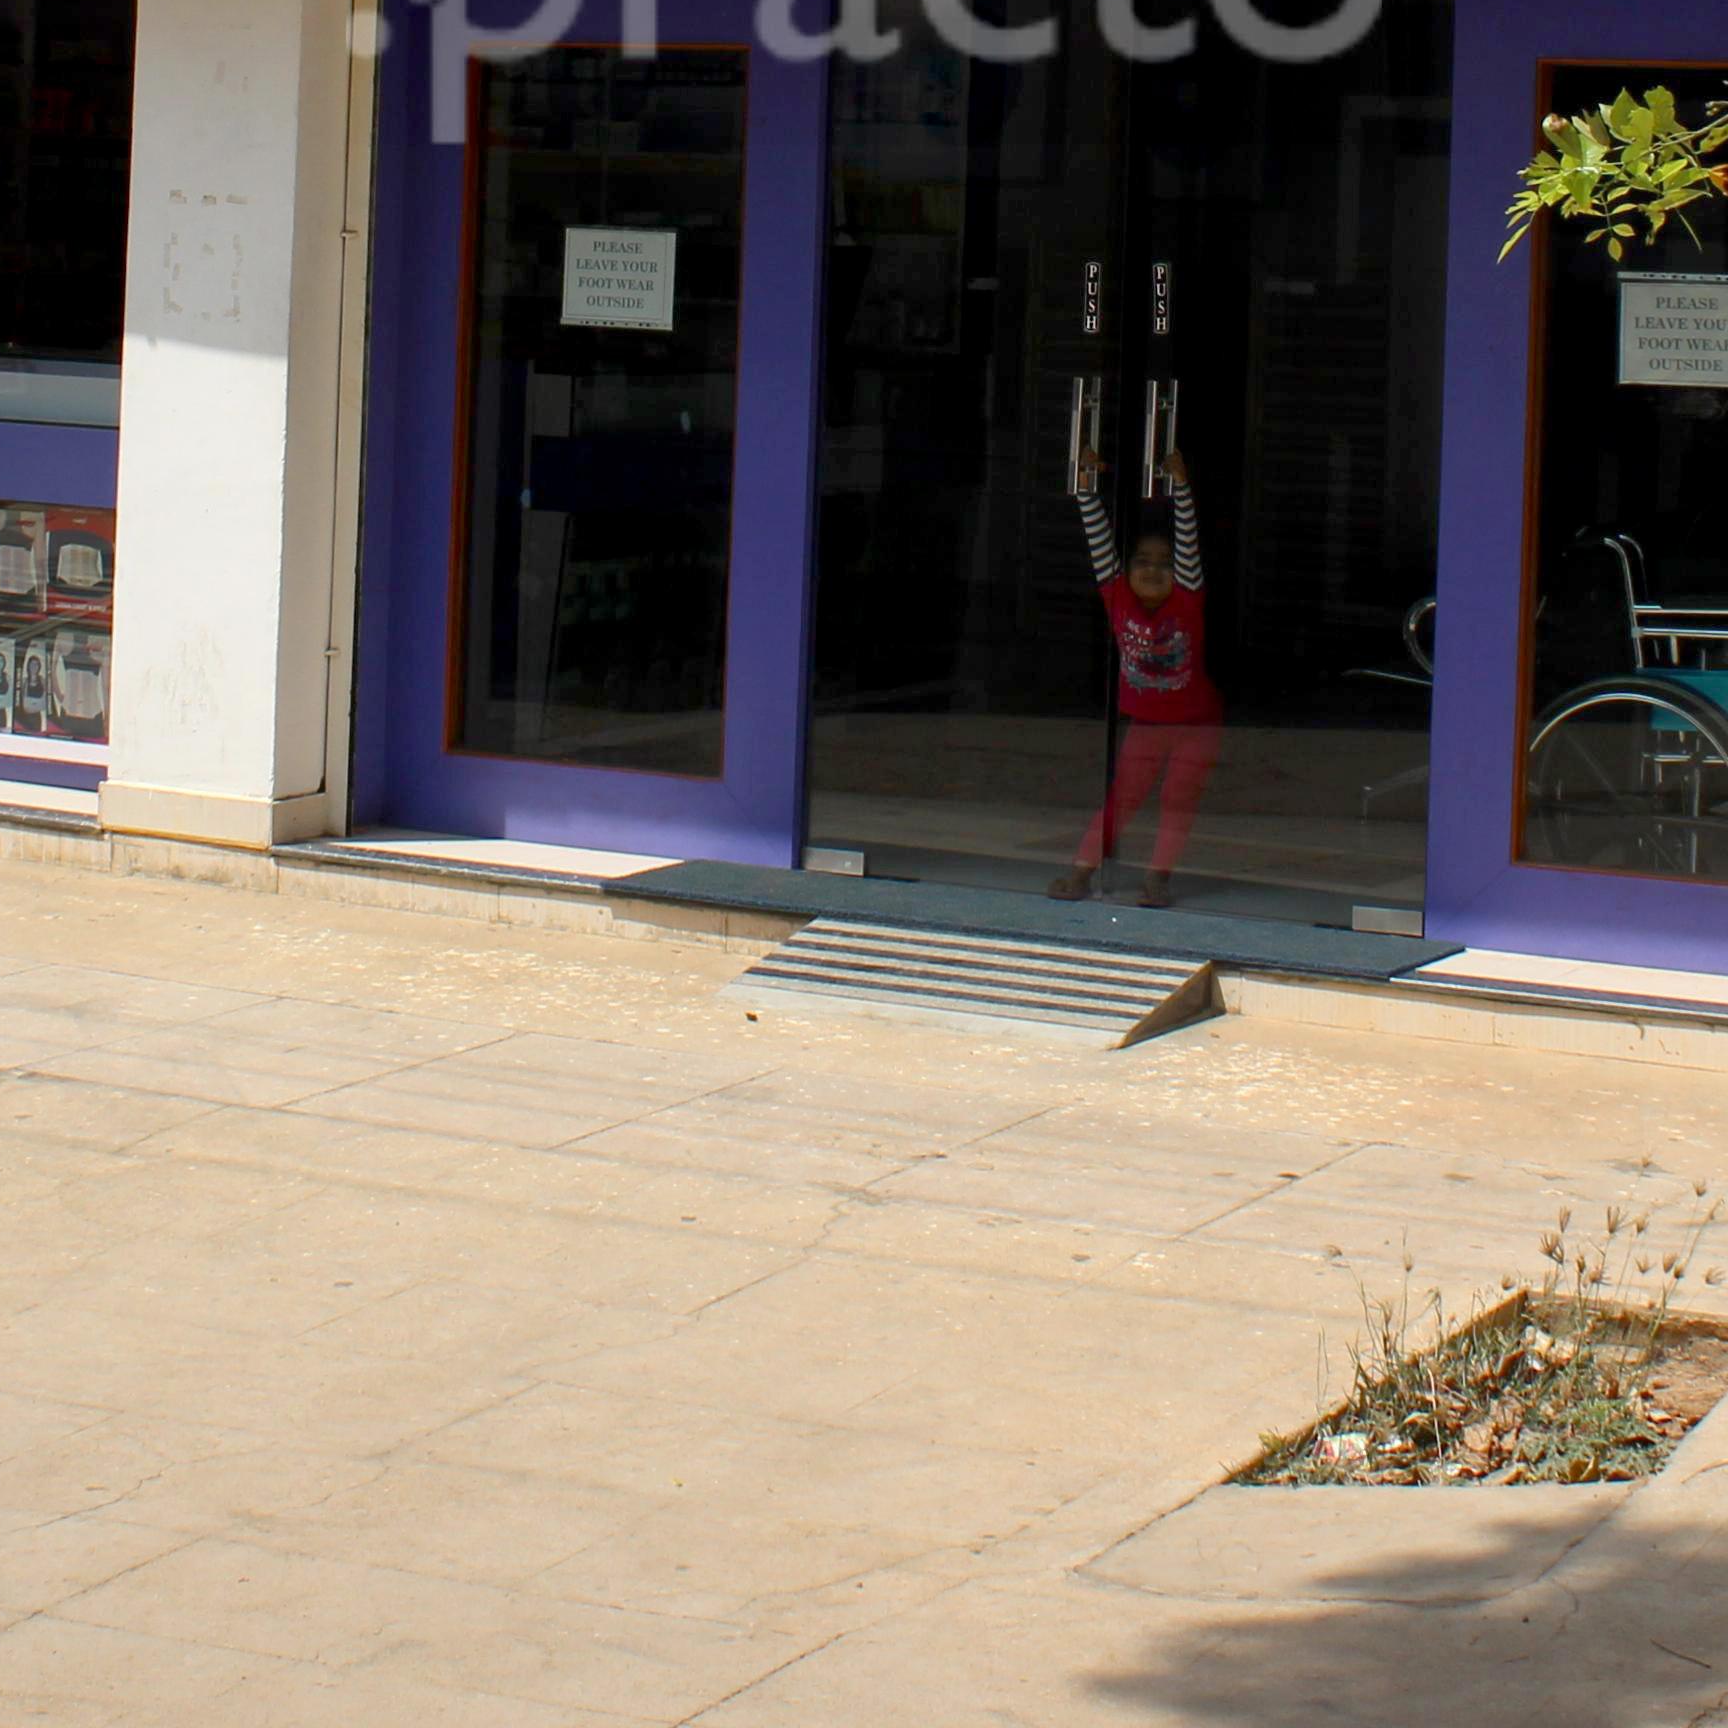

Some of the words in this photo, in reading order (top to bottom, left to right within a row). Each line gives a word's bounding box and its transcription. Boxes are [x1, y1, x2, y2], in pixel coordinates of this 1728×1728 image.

[593, 240, 643, 255] PLEASE
[576, 258, 618, 271] LEAVE
[622, 260, 658, 273] YOUR
[578, 276, 614, 289] FOOT
[617, 279, 654, 291] WEAR
[586, 295, 645, 310] OUTSIDE
[1086, 264, 1098, 329] PUSH
[1156, 266, 1166, 331] PUSH
[1656, 296, 1719, 310] PLEASE
[1634, 316, 1688, 330] LEAVE
[1638, 337, 1683, 350] FOOT
[1649, 358, 1724, 372] OUTSIDE
